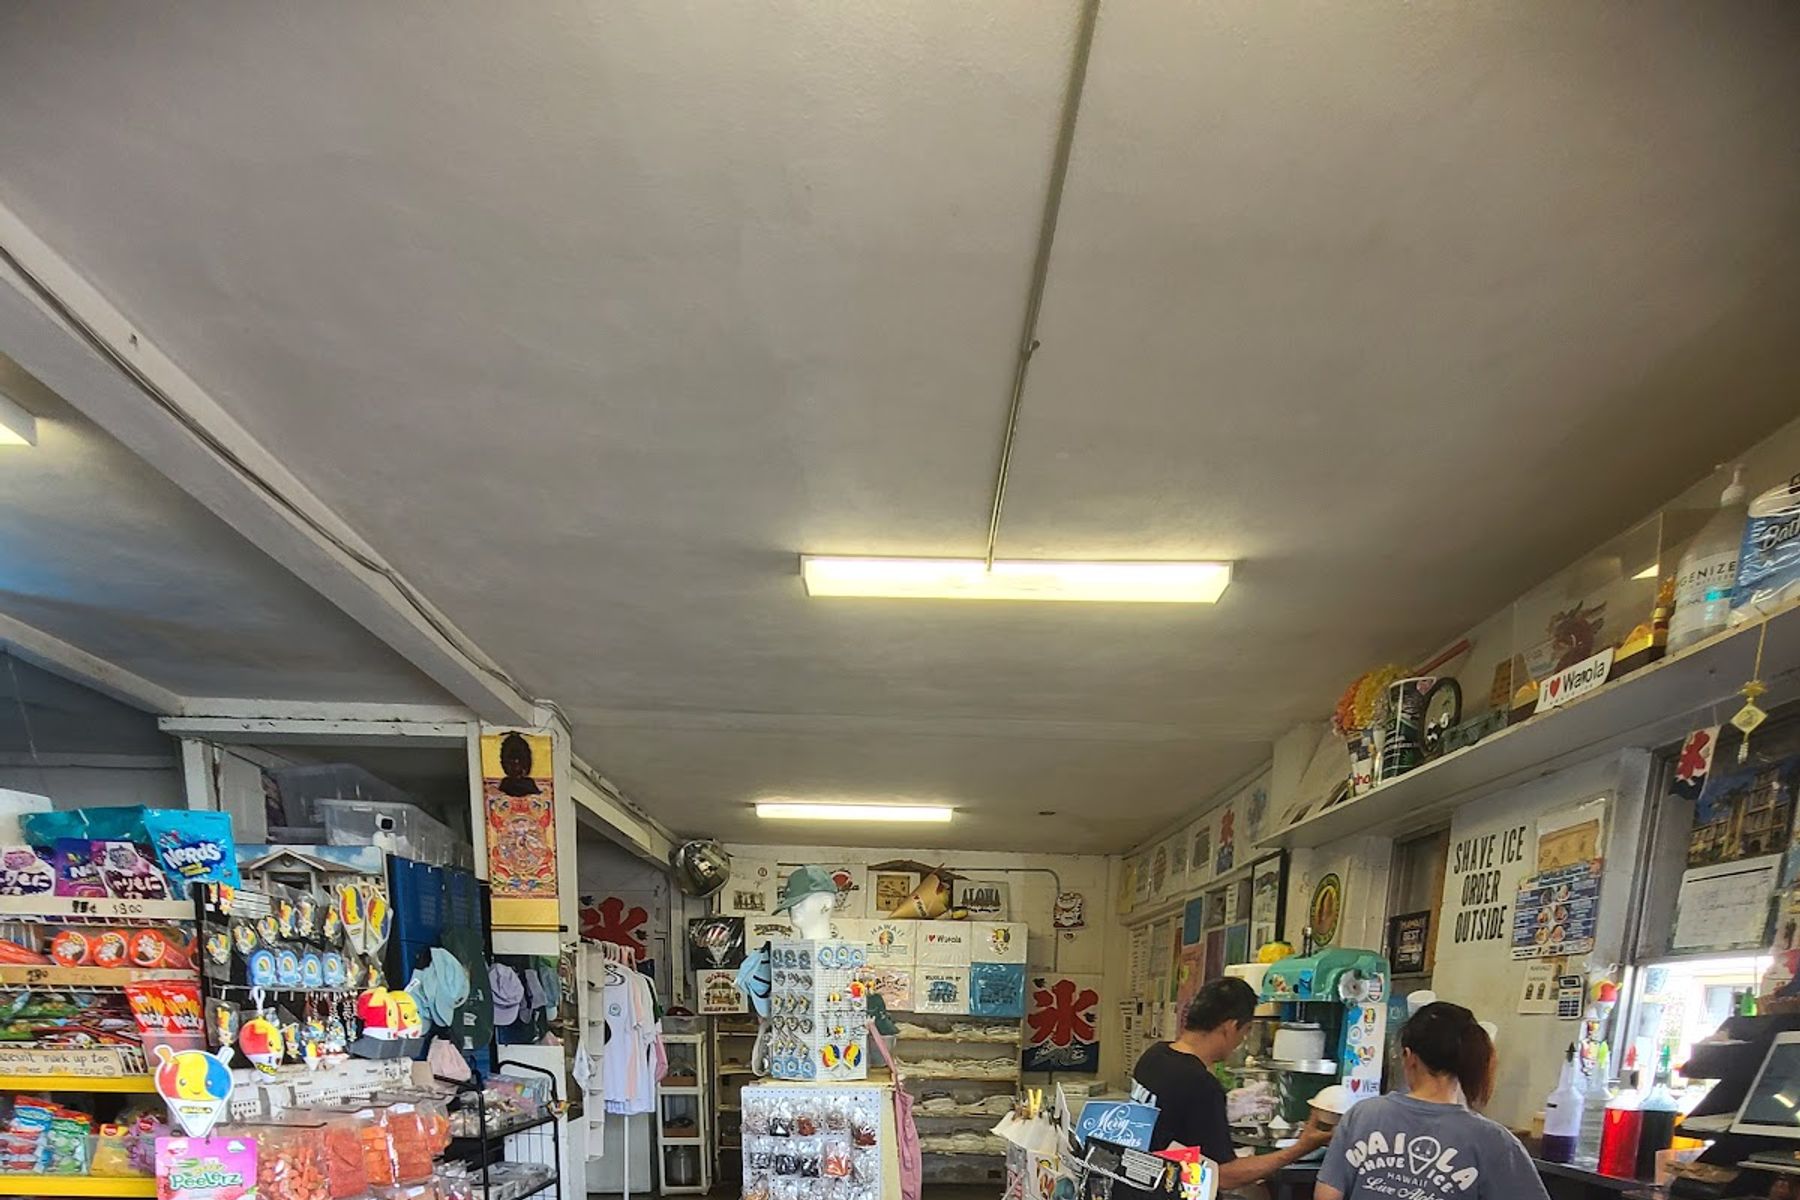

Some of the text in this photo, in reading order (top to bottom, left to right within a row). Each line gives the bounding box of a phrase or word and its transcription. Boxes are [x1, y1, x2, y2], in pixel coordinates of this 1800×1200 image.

[1454, 826, 1526, 874] SHAVE ICE
[1461, 870, 1502, 907] ORDER
[1454, 905, 1507, 944] OUTSIDE
[1358, 1157, 1405, 1175] SHAVE
[1387, 1172, 1428, 1187] HAWAII
